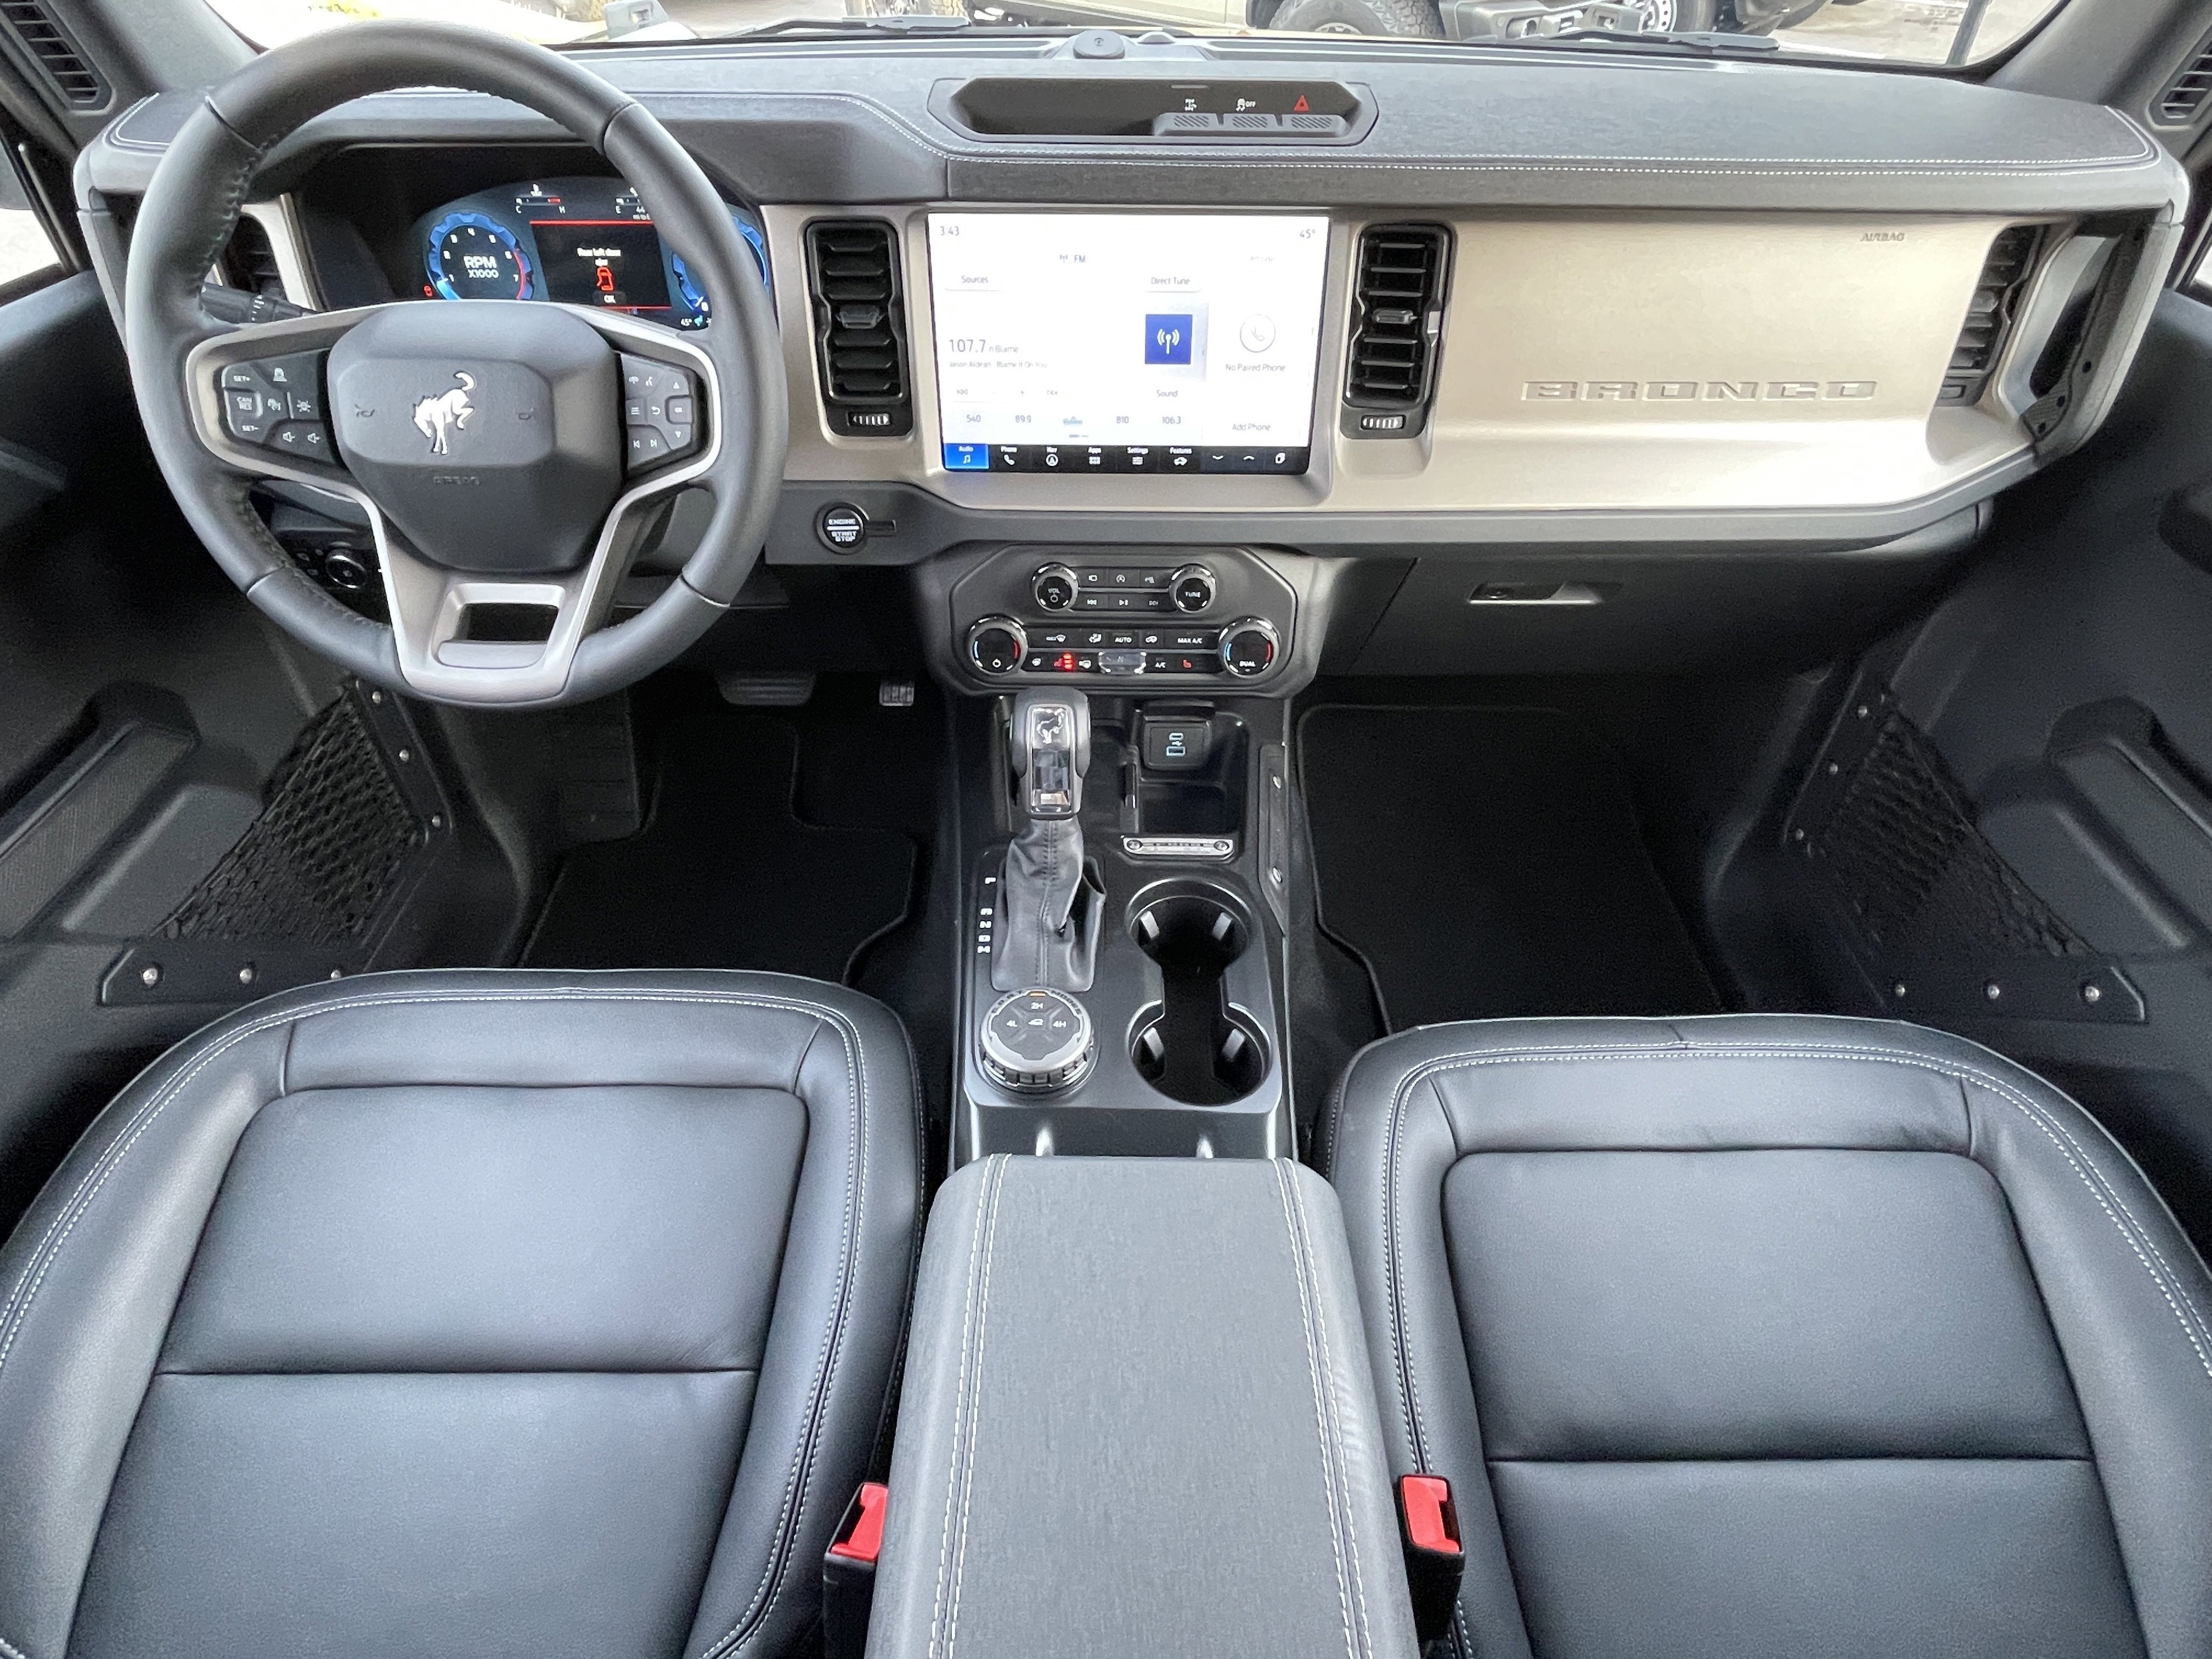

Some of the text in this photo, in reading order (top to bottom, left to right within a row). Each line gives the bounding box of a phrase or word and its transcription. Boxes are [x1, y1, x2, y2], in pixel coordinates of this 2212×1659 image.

[1859, 233, 1905, 241] AIRBAG
[463, 256, 498, 268] RPM
[1074, 255, 1086, 263] FM
[961, 275, 989, 284] Sources
[1150, 276, 1190, 285] Direct Tune
[949, 339, 986, 353] 107.7
[995, 345, 1019, 353] Blame
[1226, 363, 1286, 373] No Paired Phone
[1156, 390, 1178, 398] Sound
[1521, 380, 1878, 401] BRONCO
[1015, 415, 1031, 423] 89.9
[1162, 416, 1182, 424] 106.3
[1232, 423, 1271, 431] Add Phone
[1006, 1019, 1018, 1028] 4L
[1052, 1019, 1066, 1028] 4H
